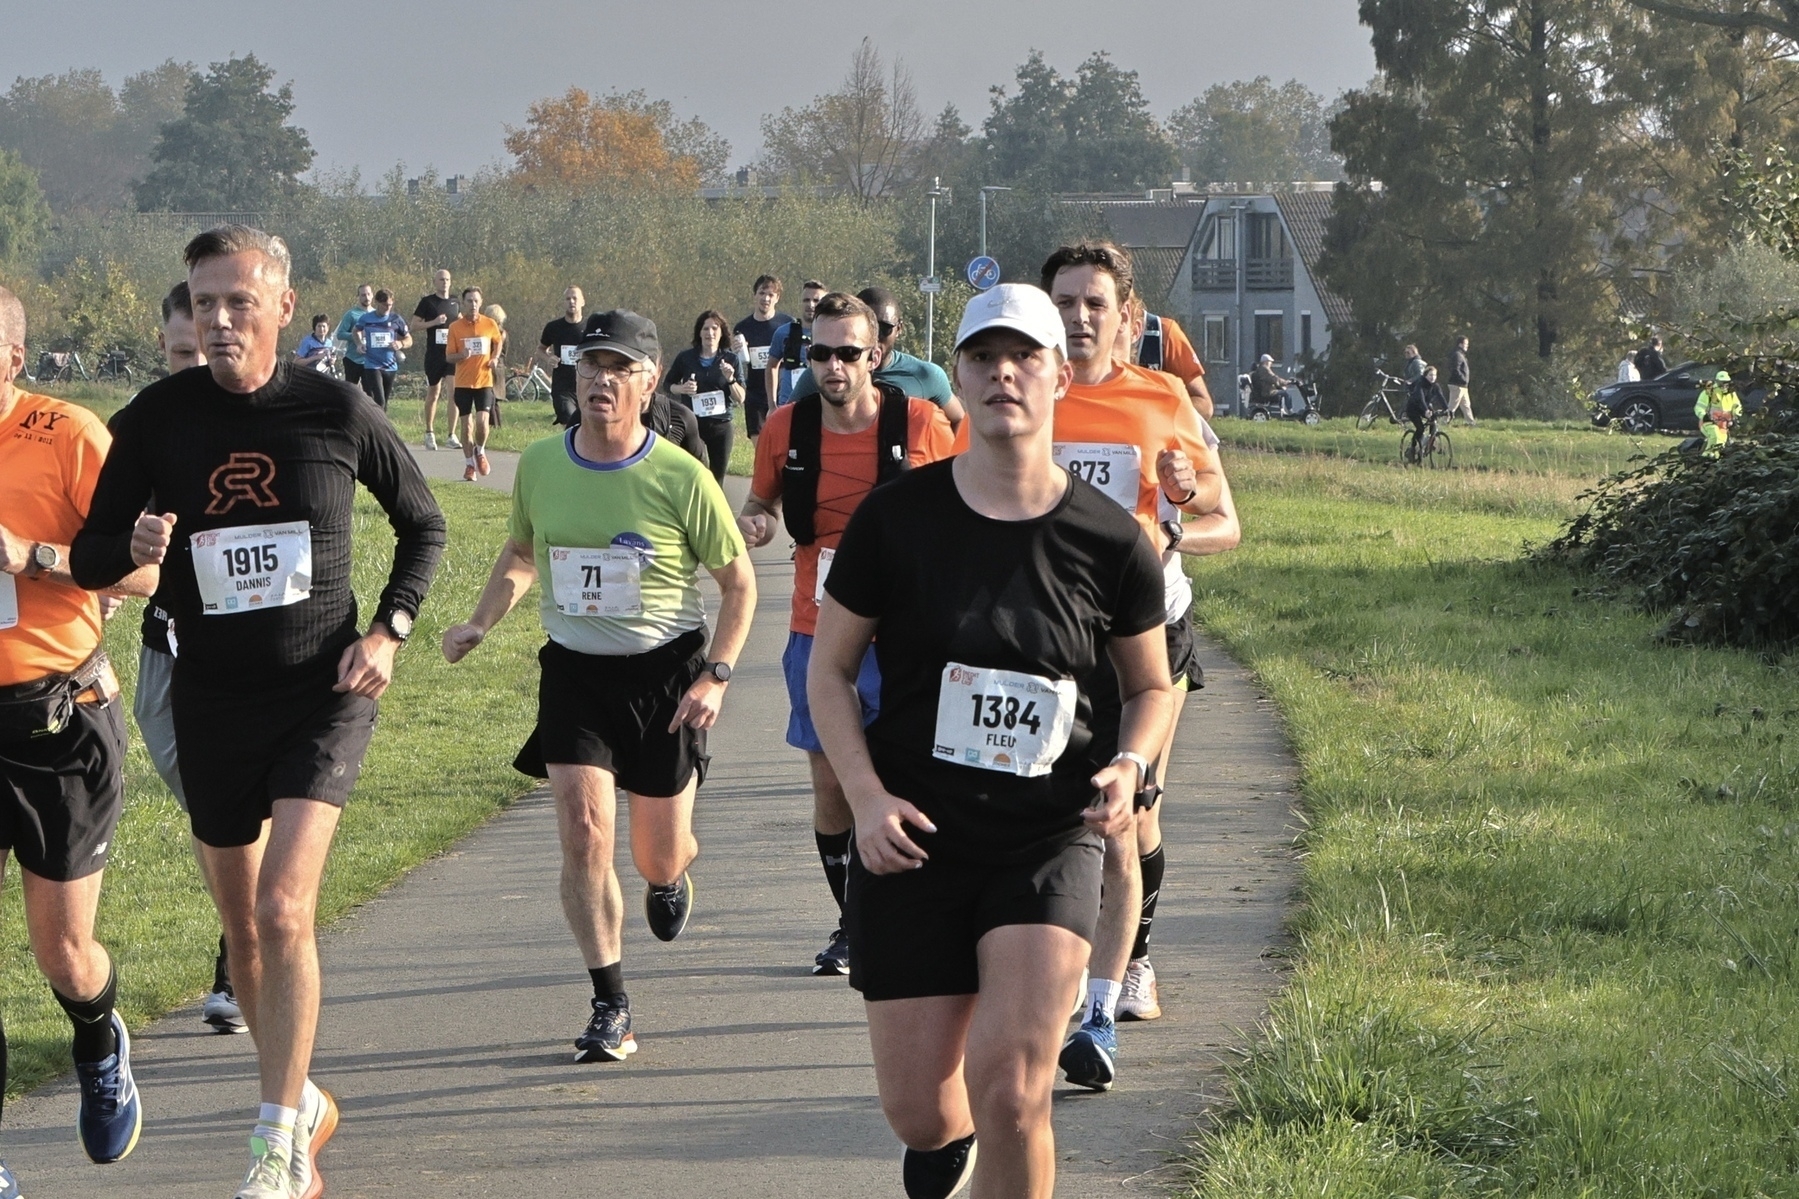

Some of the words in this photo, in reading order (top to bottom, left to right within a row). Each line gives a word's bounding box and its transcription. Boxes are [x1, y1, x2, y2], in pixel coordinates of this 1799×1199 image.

[700, 397, 717, 408] 1931
[19, 410, 70, 431] NY
[1068, 460, 1111, 486] 873
[234, 532, 262, 540] MULDER
[222, 543, 279, 578] 1915
[236, 576, 272, 592] DANNIS
[581, 565, 602, 589] 71
[582, 592, 603, 601] RENE
[993, 679, 1025, 690] MULDER
[971, 693, 1042, 736] 1384
